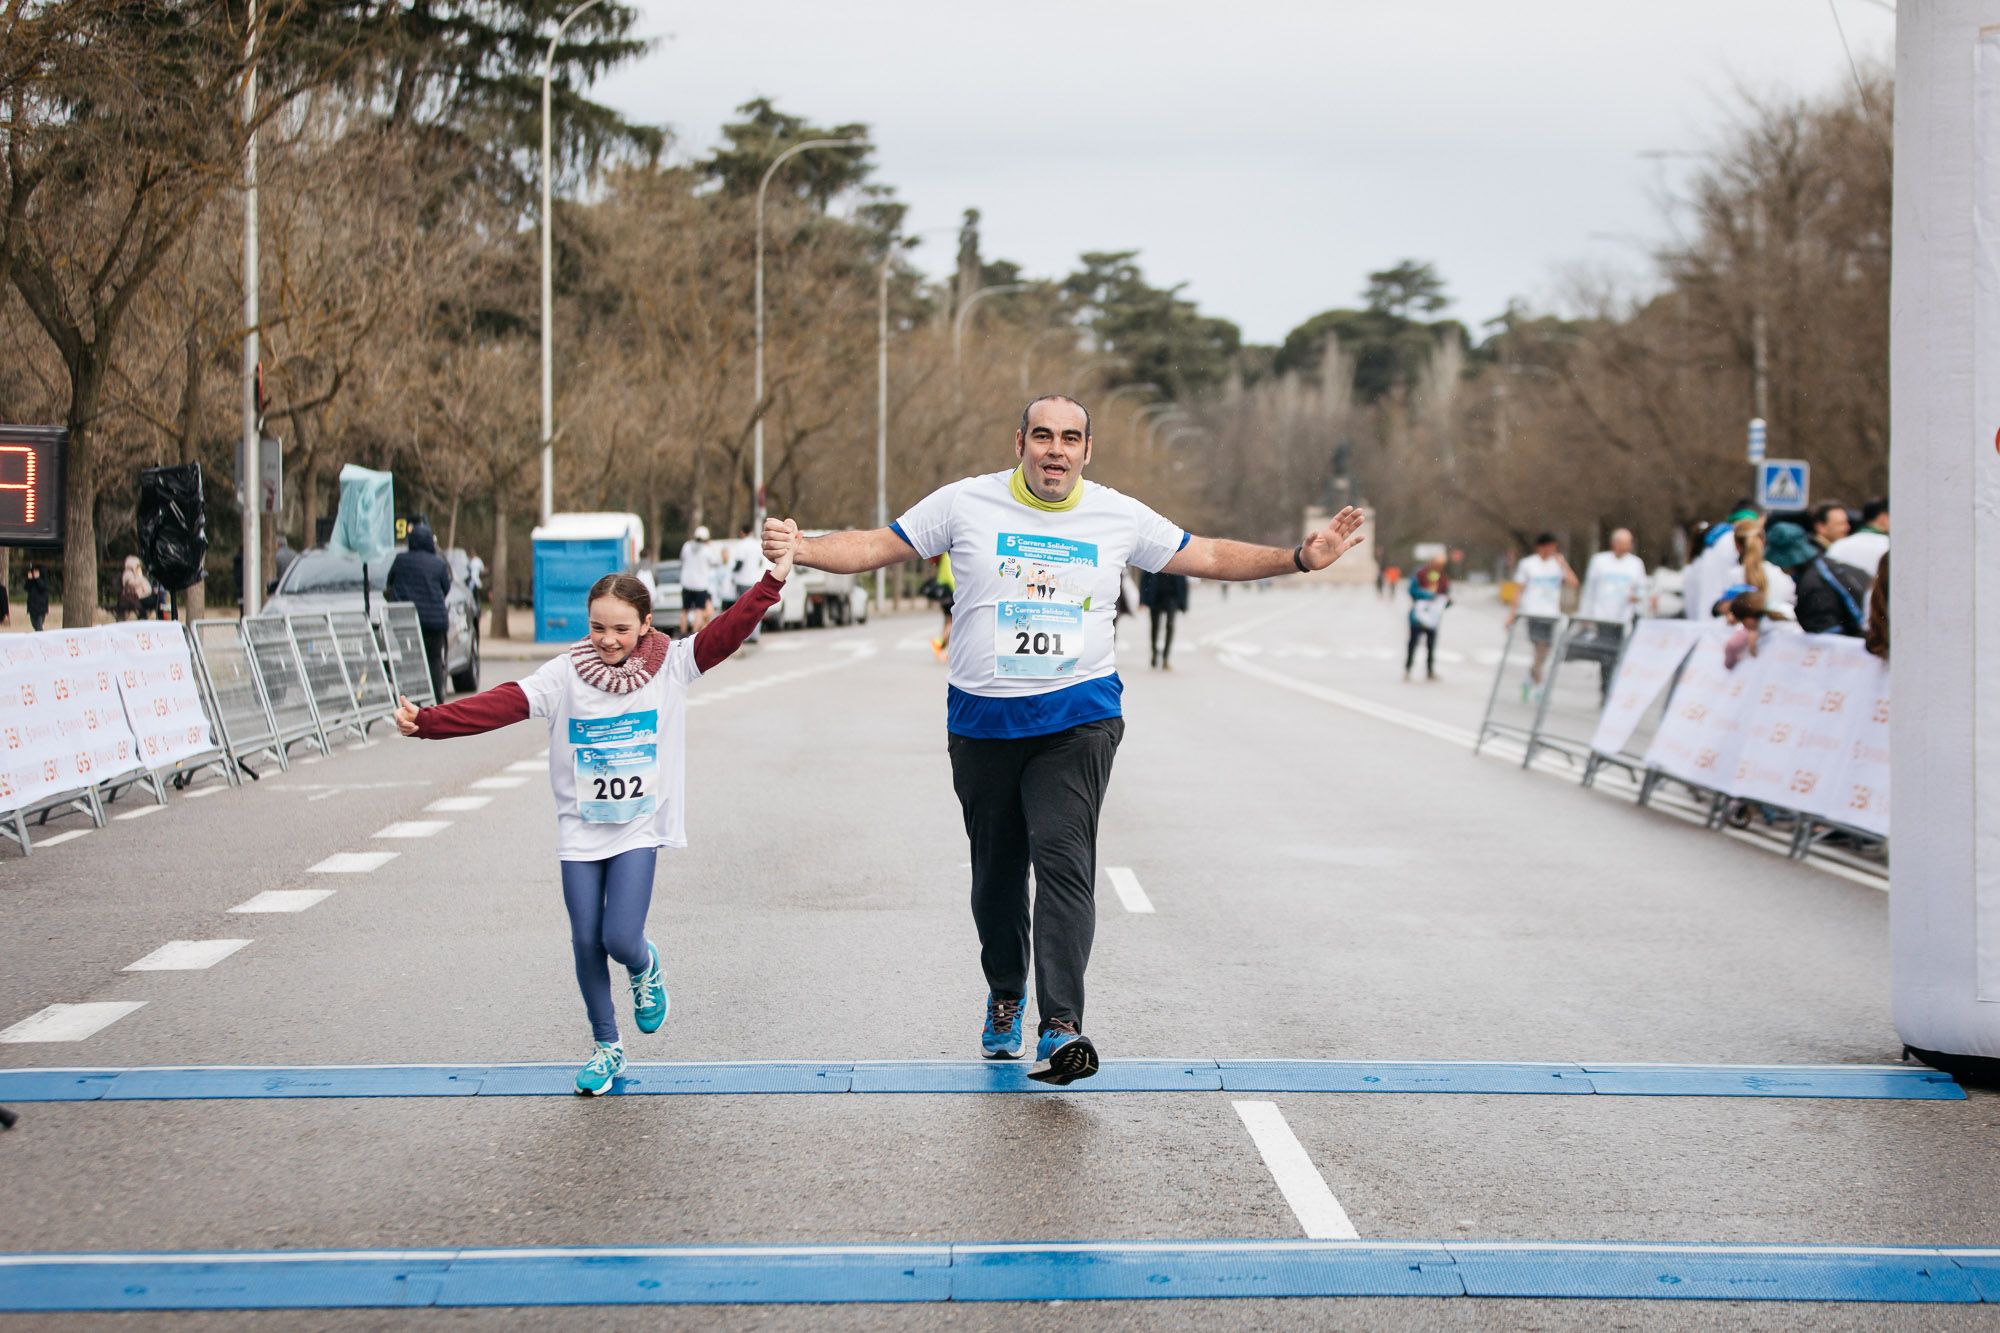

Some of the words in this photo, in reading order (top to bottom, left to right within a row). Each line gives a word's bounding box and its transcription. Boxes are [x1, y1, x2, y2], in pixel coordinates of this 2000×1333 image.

[1017, 538, 1046, 548] Carrera
[1047, 541, 1078, 552] Solidaria
[1070, 557, 1094, 567] 2026
[1015, 606, 1040, 615] Carrera
[1041, 607, 1070, 616] Solidaria
[1015, 631, 1064, 656] 201
[593, 776, 644, 800] 202
